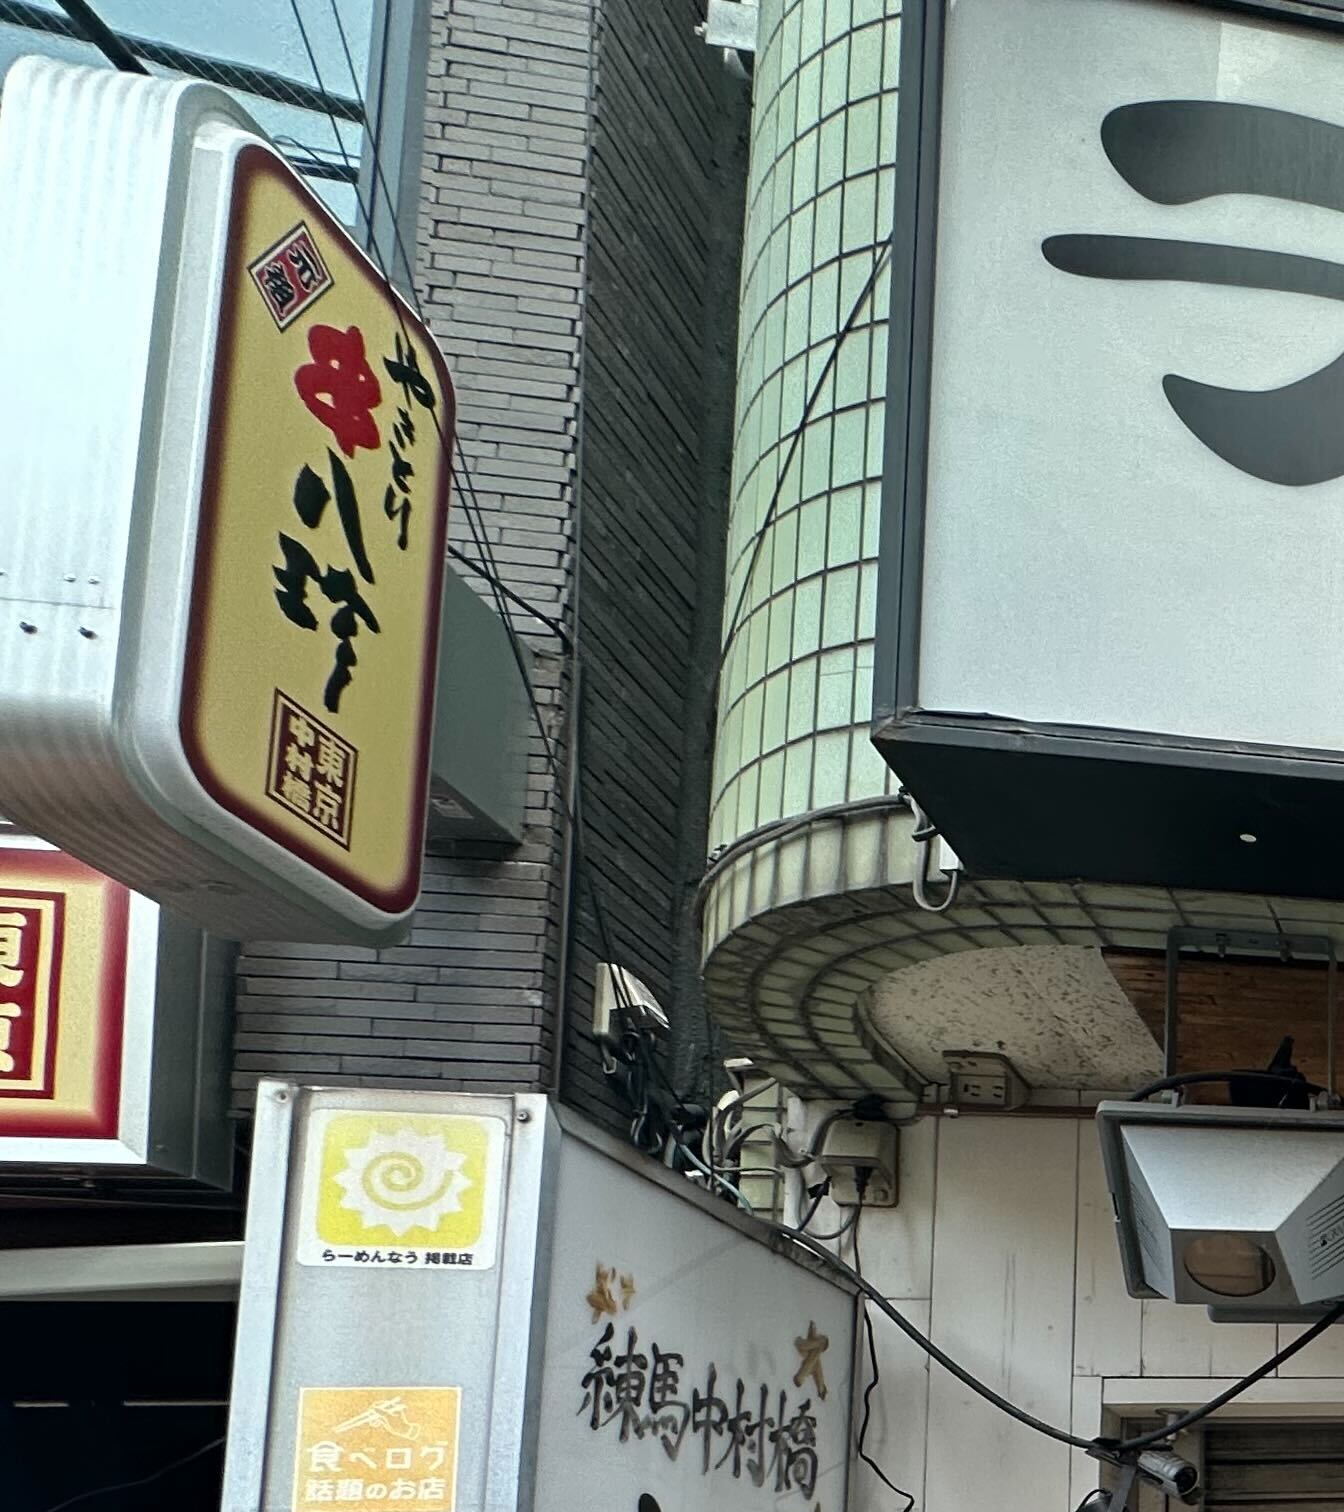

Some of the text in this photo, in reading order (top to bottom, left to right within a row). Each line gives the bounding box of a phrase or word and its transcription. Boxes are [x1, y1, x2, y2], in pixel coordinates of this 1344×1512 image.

[313, 733, 347, 833] 東京
[306, 1440, 448, 1473] 食べログ
[576, 1322, 818, 1500] 練馬中村橋
